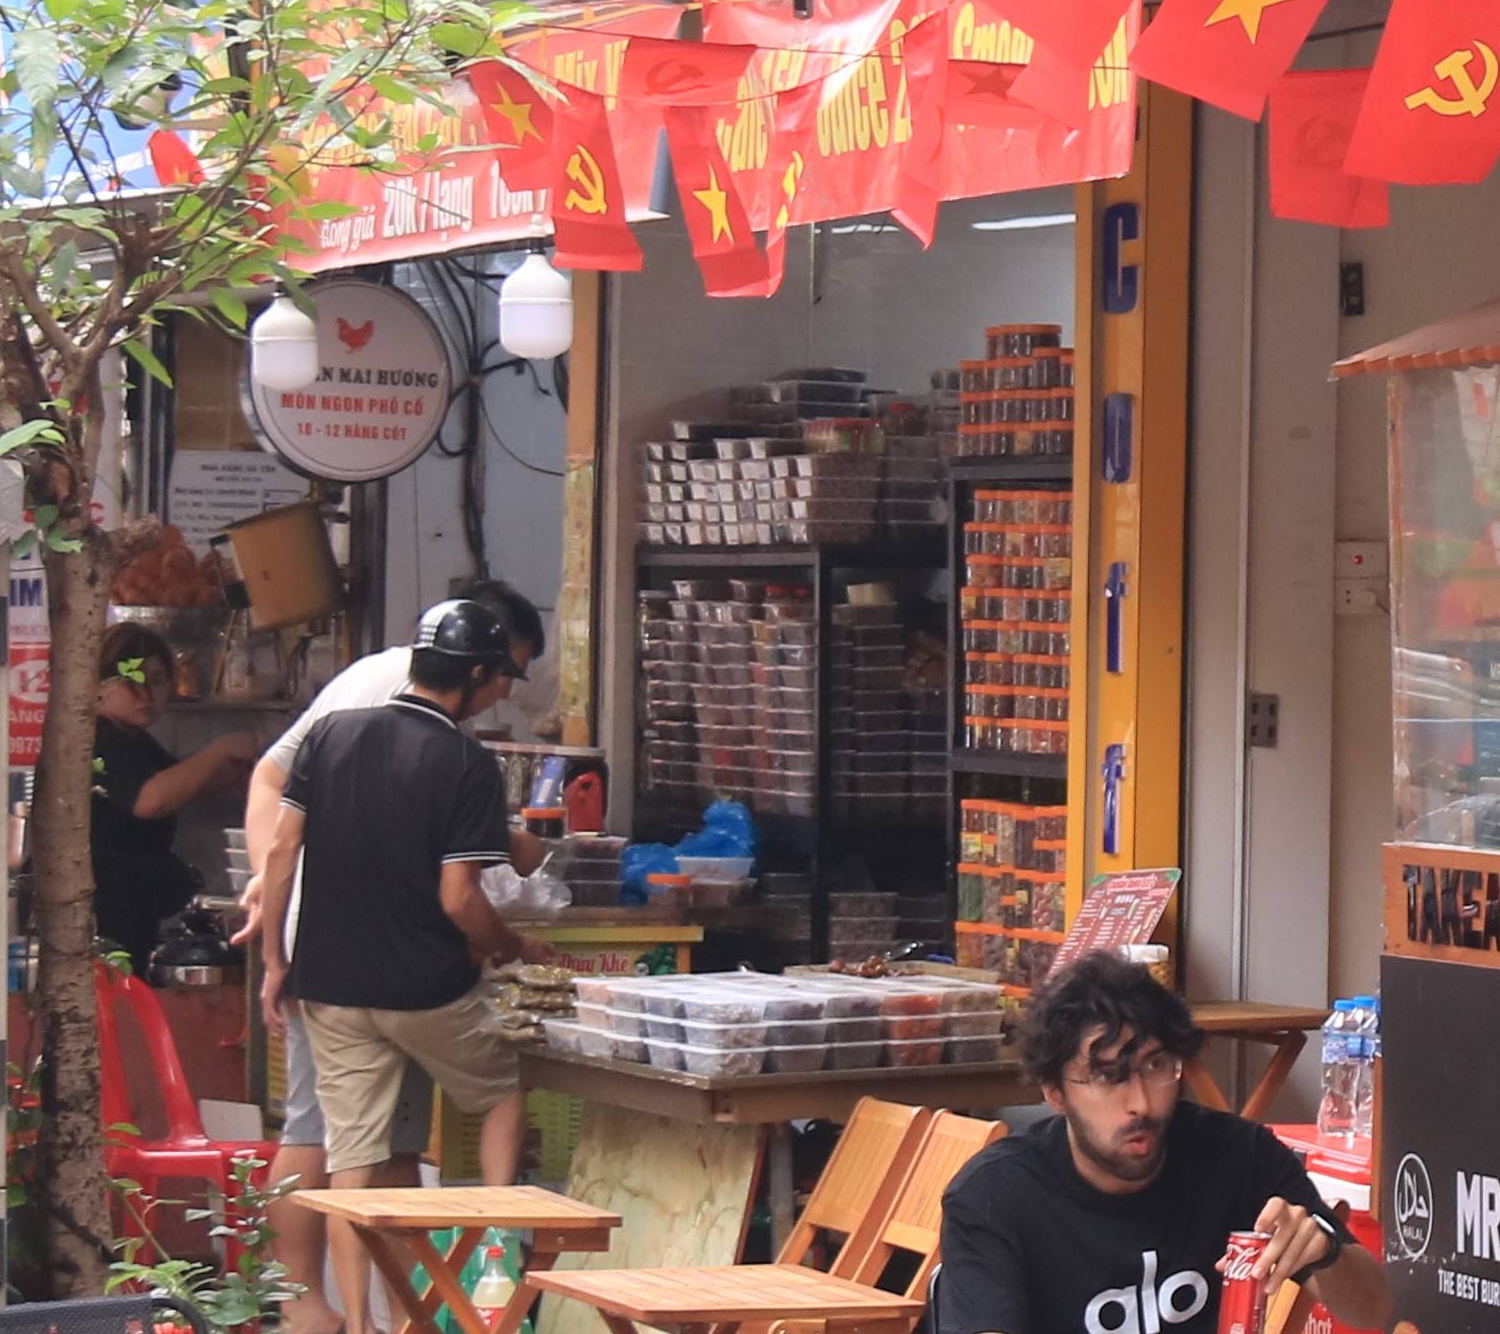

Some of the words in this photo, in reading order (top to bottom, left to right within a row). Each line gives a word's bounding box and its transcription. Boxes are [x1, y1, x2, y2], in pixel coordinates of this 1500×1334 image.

[339, 369, 372, 385] MAI
[376, 369, 439, 388] HƯƠNG
[321, 395, 364, 412] NGON
[1402, 1225, 1424, 1242] HALAL
[1438, 1269, 1455, 1294] THE
[1457, 1274, 1479, 1301] BEST
